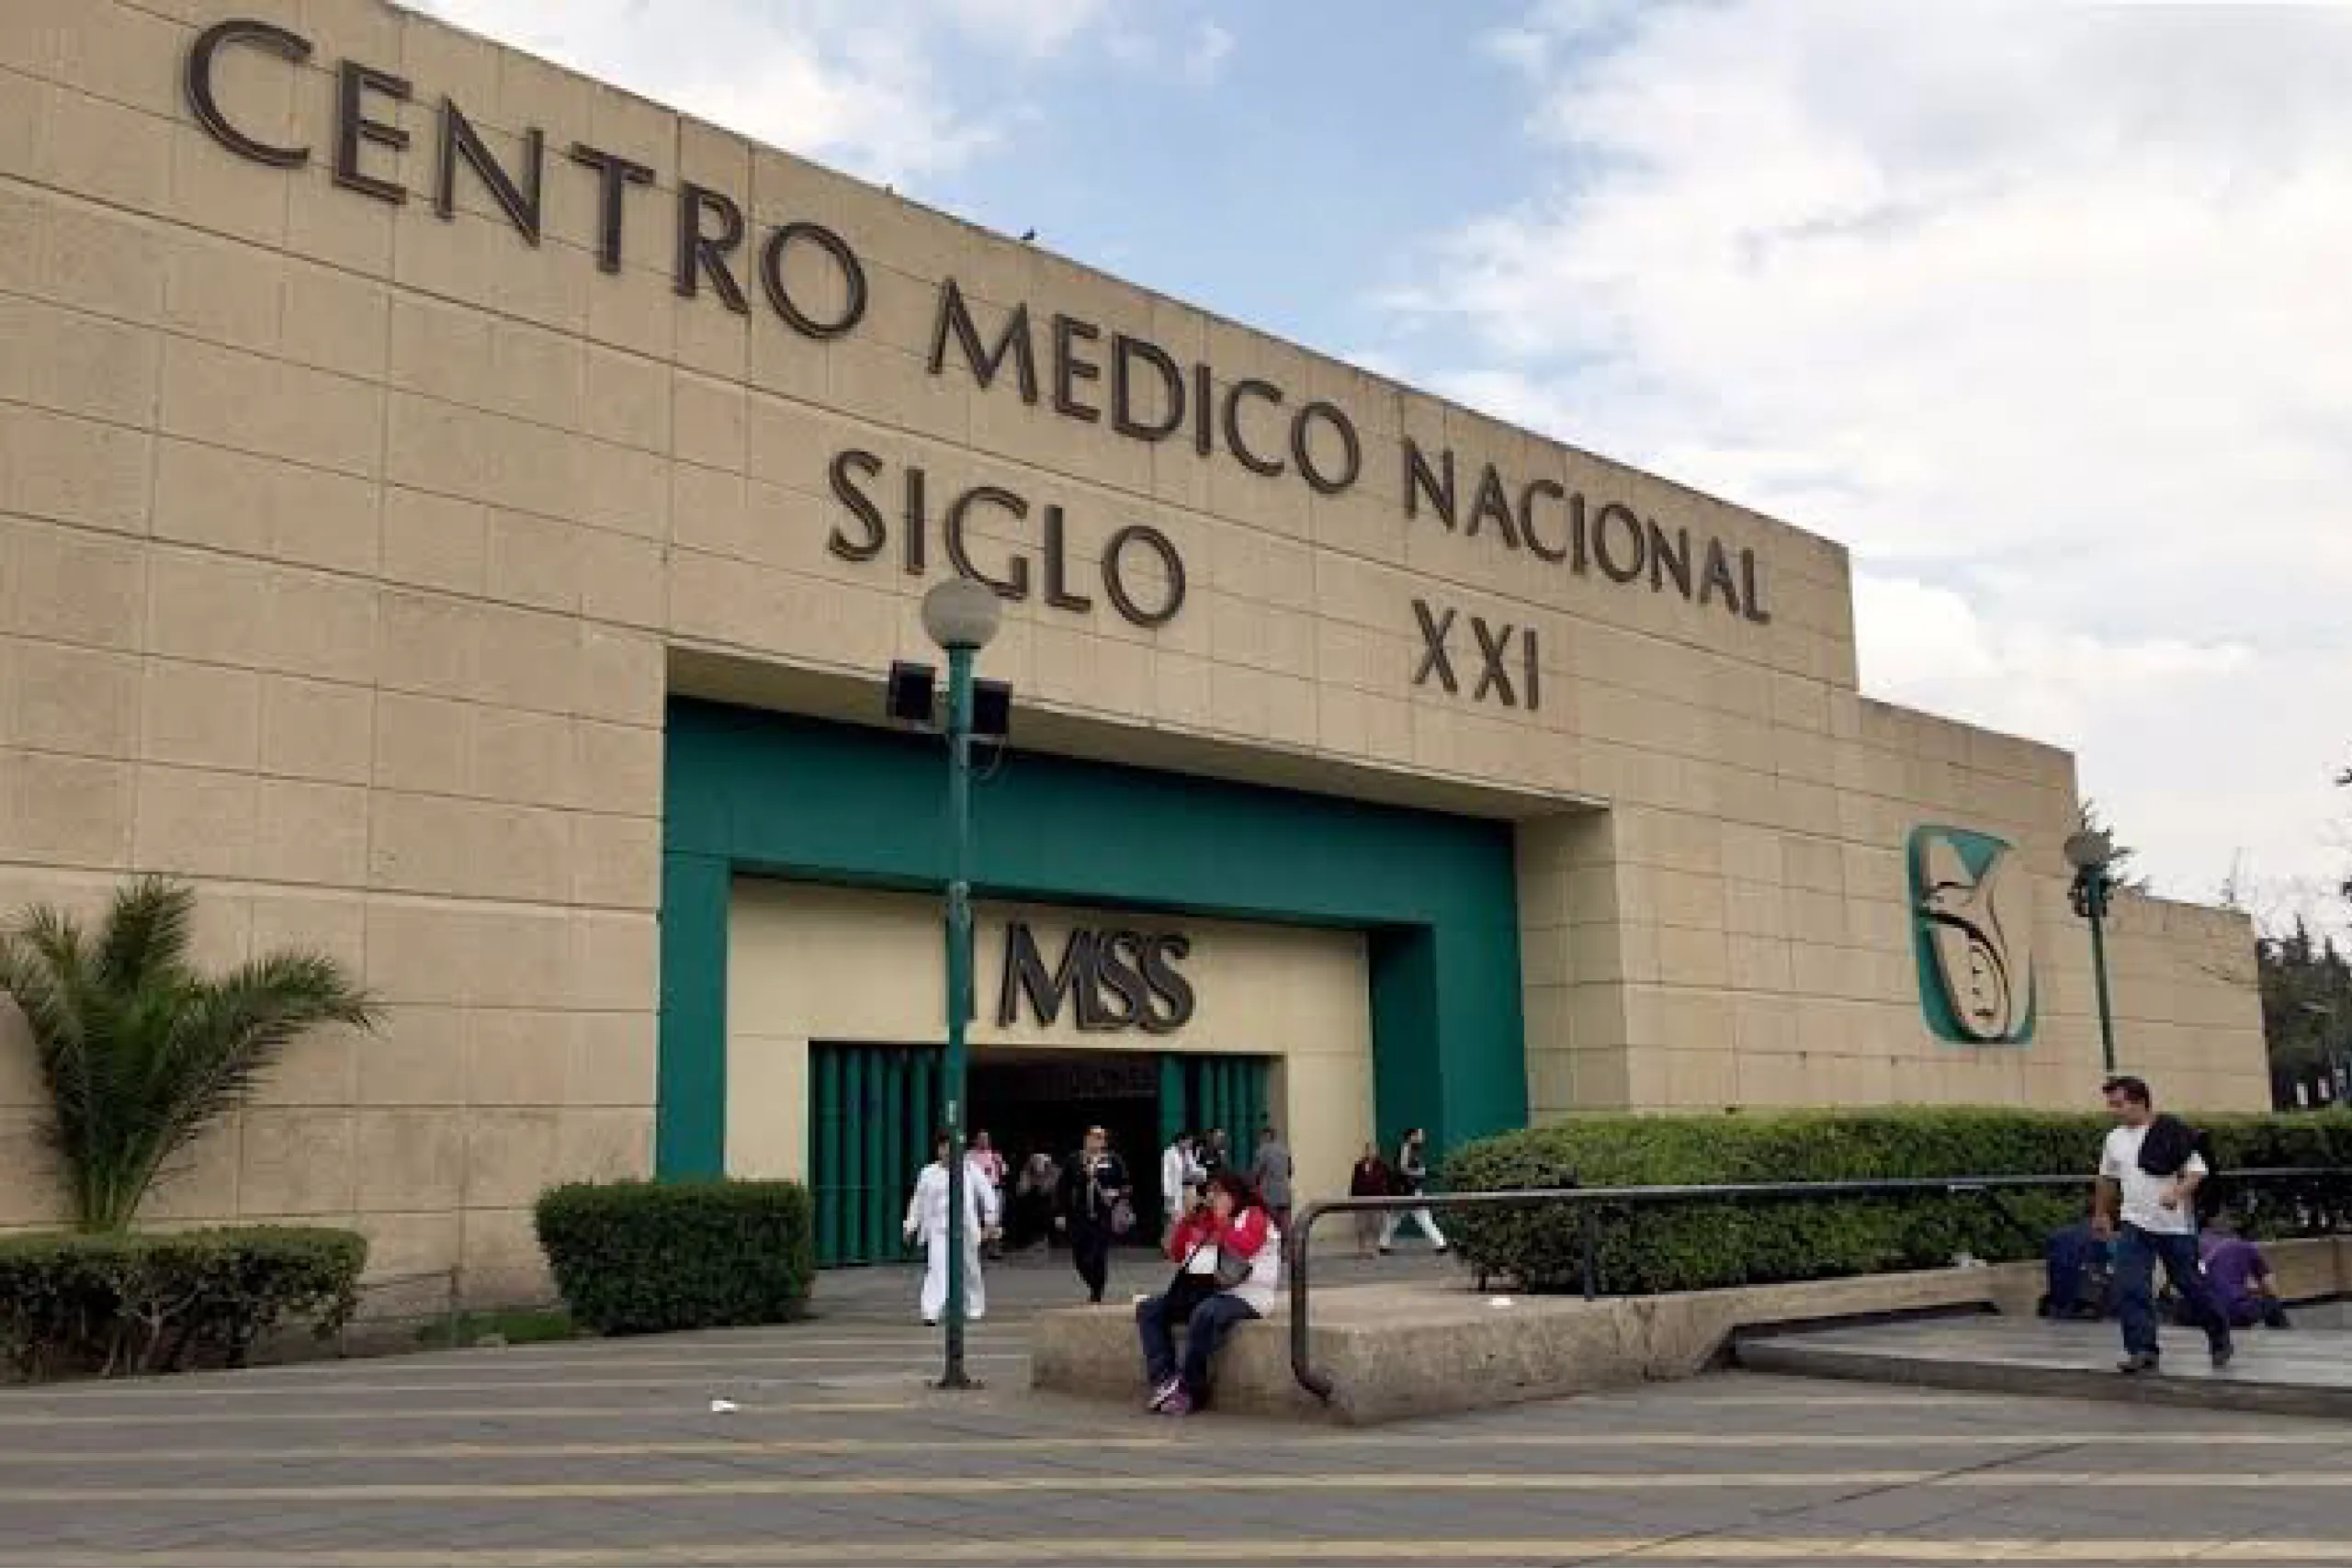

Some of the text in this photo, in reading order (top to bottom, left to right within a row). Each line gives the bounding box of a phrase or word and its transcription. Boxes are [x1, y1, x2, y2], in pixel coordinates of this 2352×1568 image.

[186, 19, 1770, 625] CENTRO MEDICO NACIONAL
[829, 448, 1540, 710] SIGLO XXI
